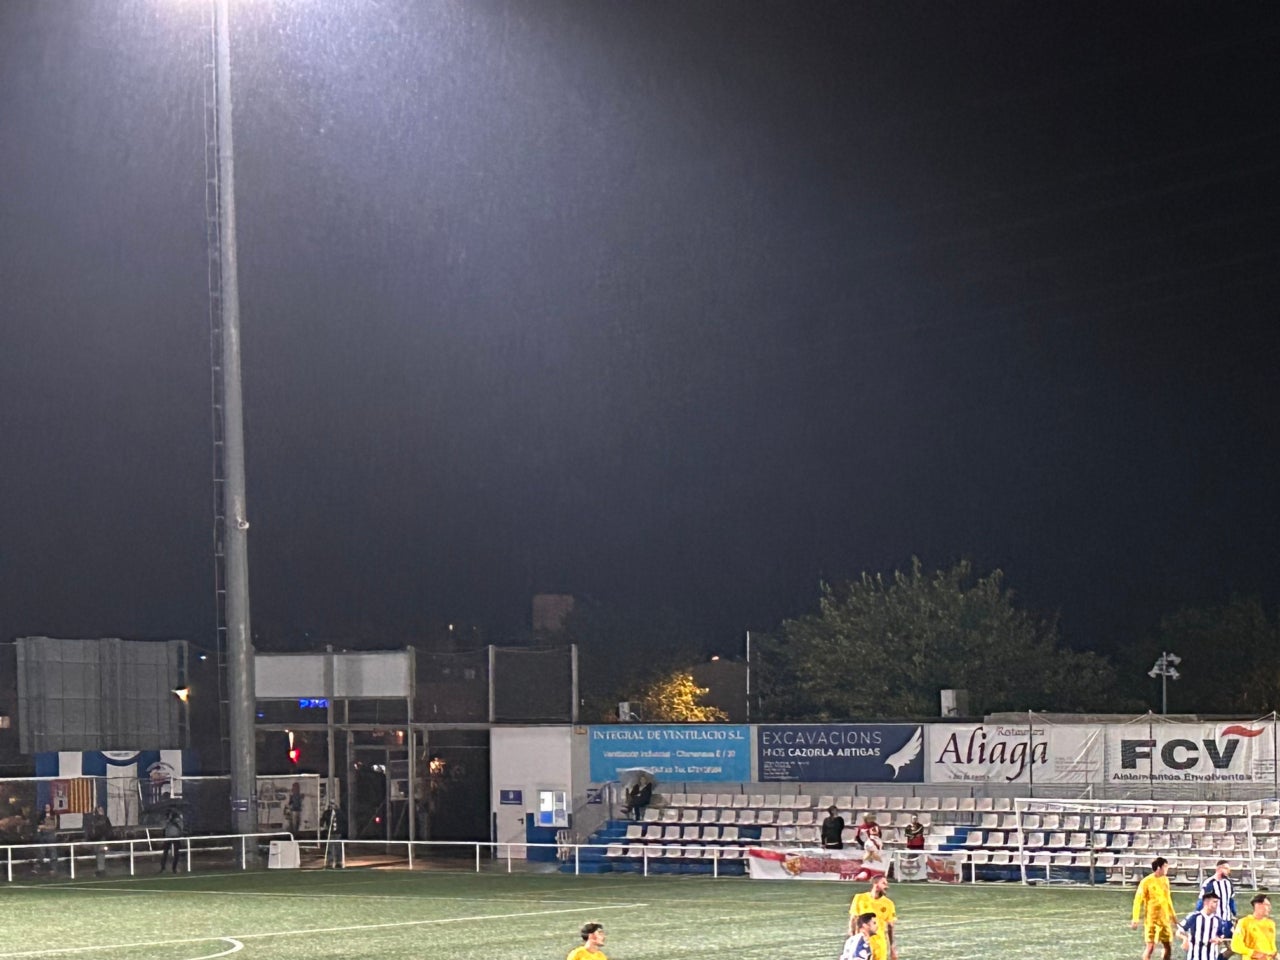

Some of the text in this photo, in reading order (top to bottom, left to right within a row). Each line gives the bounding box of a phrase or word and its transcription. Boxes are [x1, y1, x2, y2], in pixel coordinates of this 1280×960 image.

[647, 730, 661, 740] DE
[763, 731, 882, 745] EXCAVACIONS
[788, 748, 833, 757] CAZORLA
[836, 748, 881, 757] ARTIGAS
[935, 727, 1048, 781] Aliaga
[1121, 739, 1239, 770] FCV
